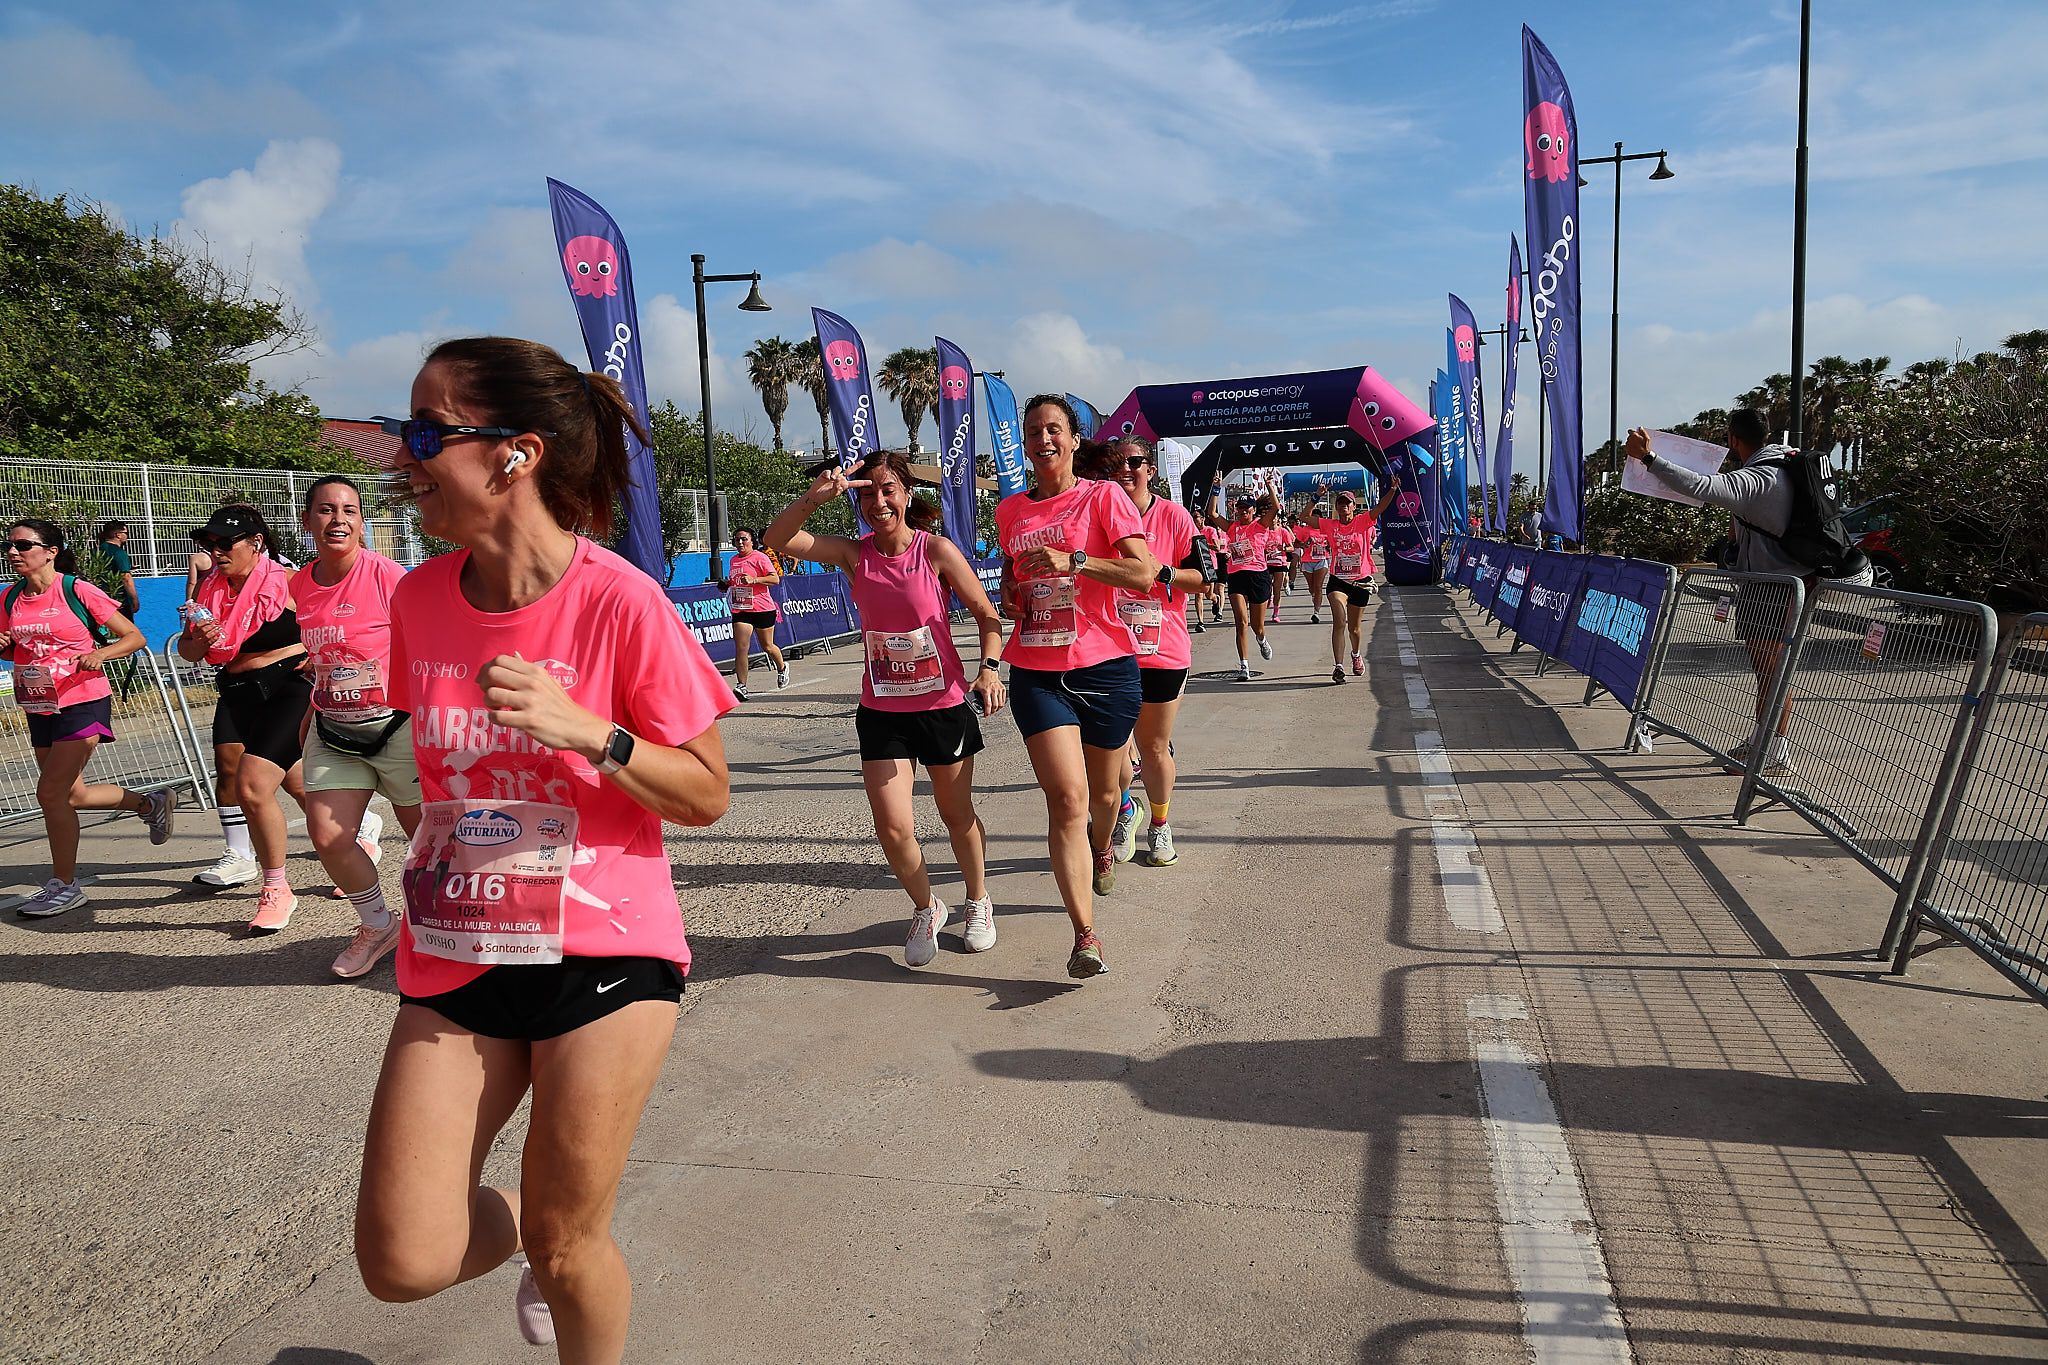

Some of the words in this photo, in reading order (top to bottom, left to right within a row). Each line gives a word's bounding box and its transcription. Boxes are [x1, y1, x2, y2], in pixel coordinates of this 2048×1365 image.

[1184, 410, 1196, 418] LA
[1199, 405, 1240, 417] ENERGÍA
[1242, 405, 1268, 415] PARA
[1270, 402, 1309, 412] CORRER
[1193, 419, 1205, 427] LA
[1208, 416, 1262, 426] VELOCIDAD
[1293, 412, 1312, 420] LUZ
[1240, 439, 1346, 454] VOLVO
[693, 597, 732, 621] CHISPA
[1033, 609, 1052, 621] 016
[1129, 624, 1143, 635] 16
[412, 659, 468, 680] OYSHO
[891, 661, 916, 673] 016
[27, 686, 47, 696] 016
[332, 689, 361, 702] 016
[458, 822, 515, 837] ASTURIANA
[445, 873, 506, 900] 016
[510, 876, 560, 886] CORREDORA
[457, 905, 486, 918] 1024
[443, 919, 453, 928] DE
[453, 920, 463, 930] LA
[464, 921, 491, 931] MUJER
[499, 921, 541, 932] VALENCIA
[425, 933, 456, 951] OYSHO
[485, 943, 541, 954] Santander
